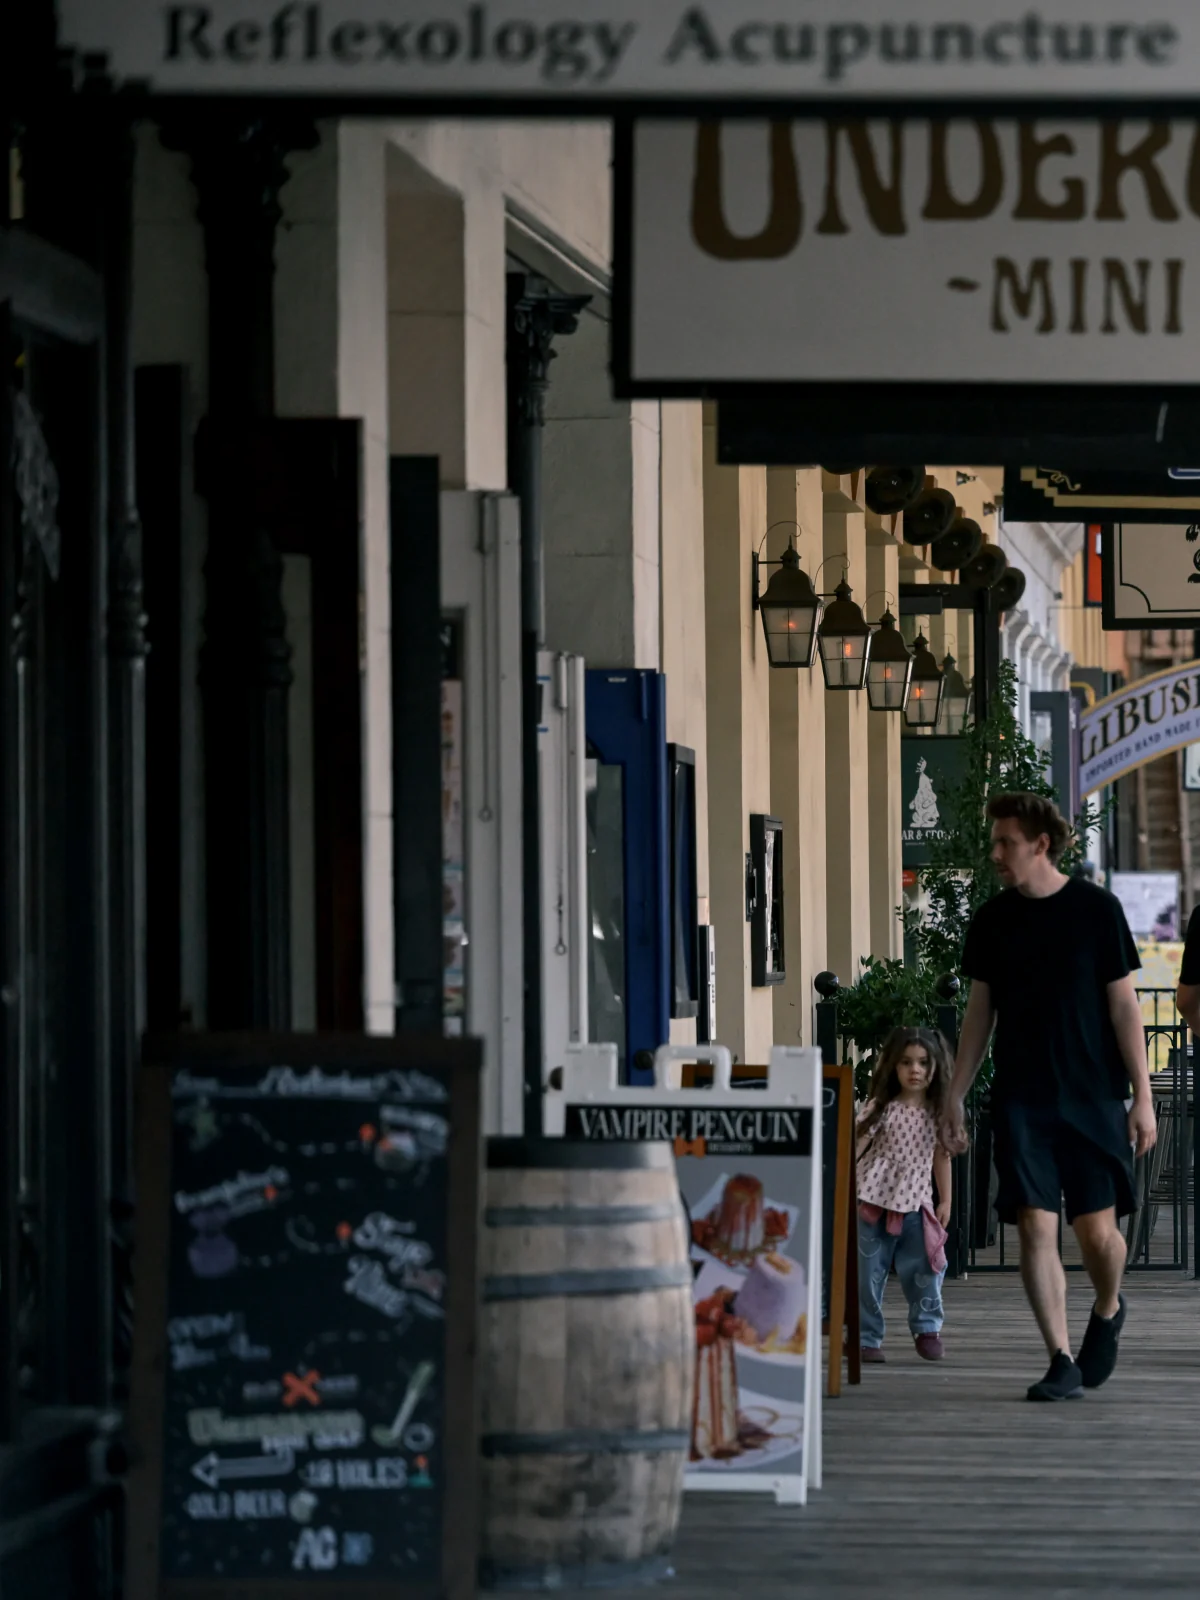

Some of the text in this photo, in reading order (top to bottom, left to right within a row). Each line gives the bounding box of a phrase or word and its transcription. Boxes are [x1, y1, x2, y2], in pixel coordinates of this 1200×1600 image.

[163, 3, 632, 80] Reflexology
[662, 8, 1178, 80] Acupuncture
[1135, 731, 1162, 753] HAND
[1164, 721, 1192, 740] MADE
[579, 1107, 800, 1142] VAMPIRE PENGUIN
